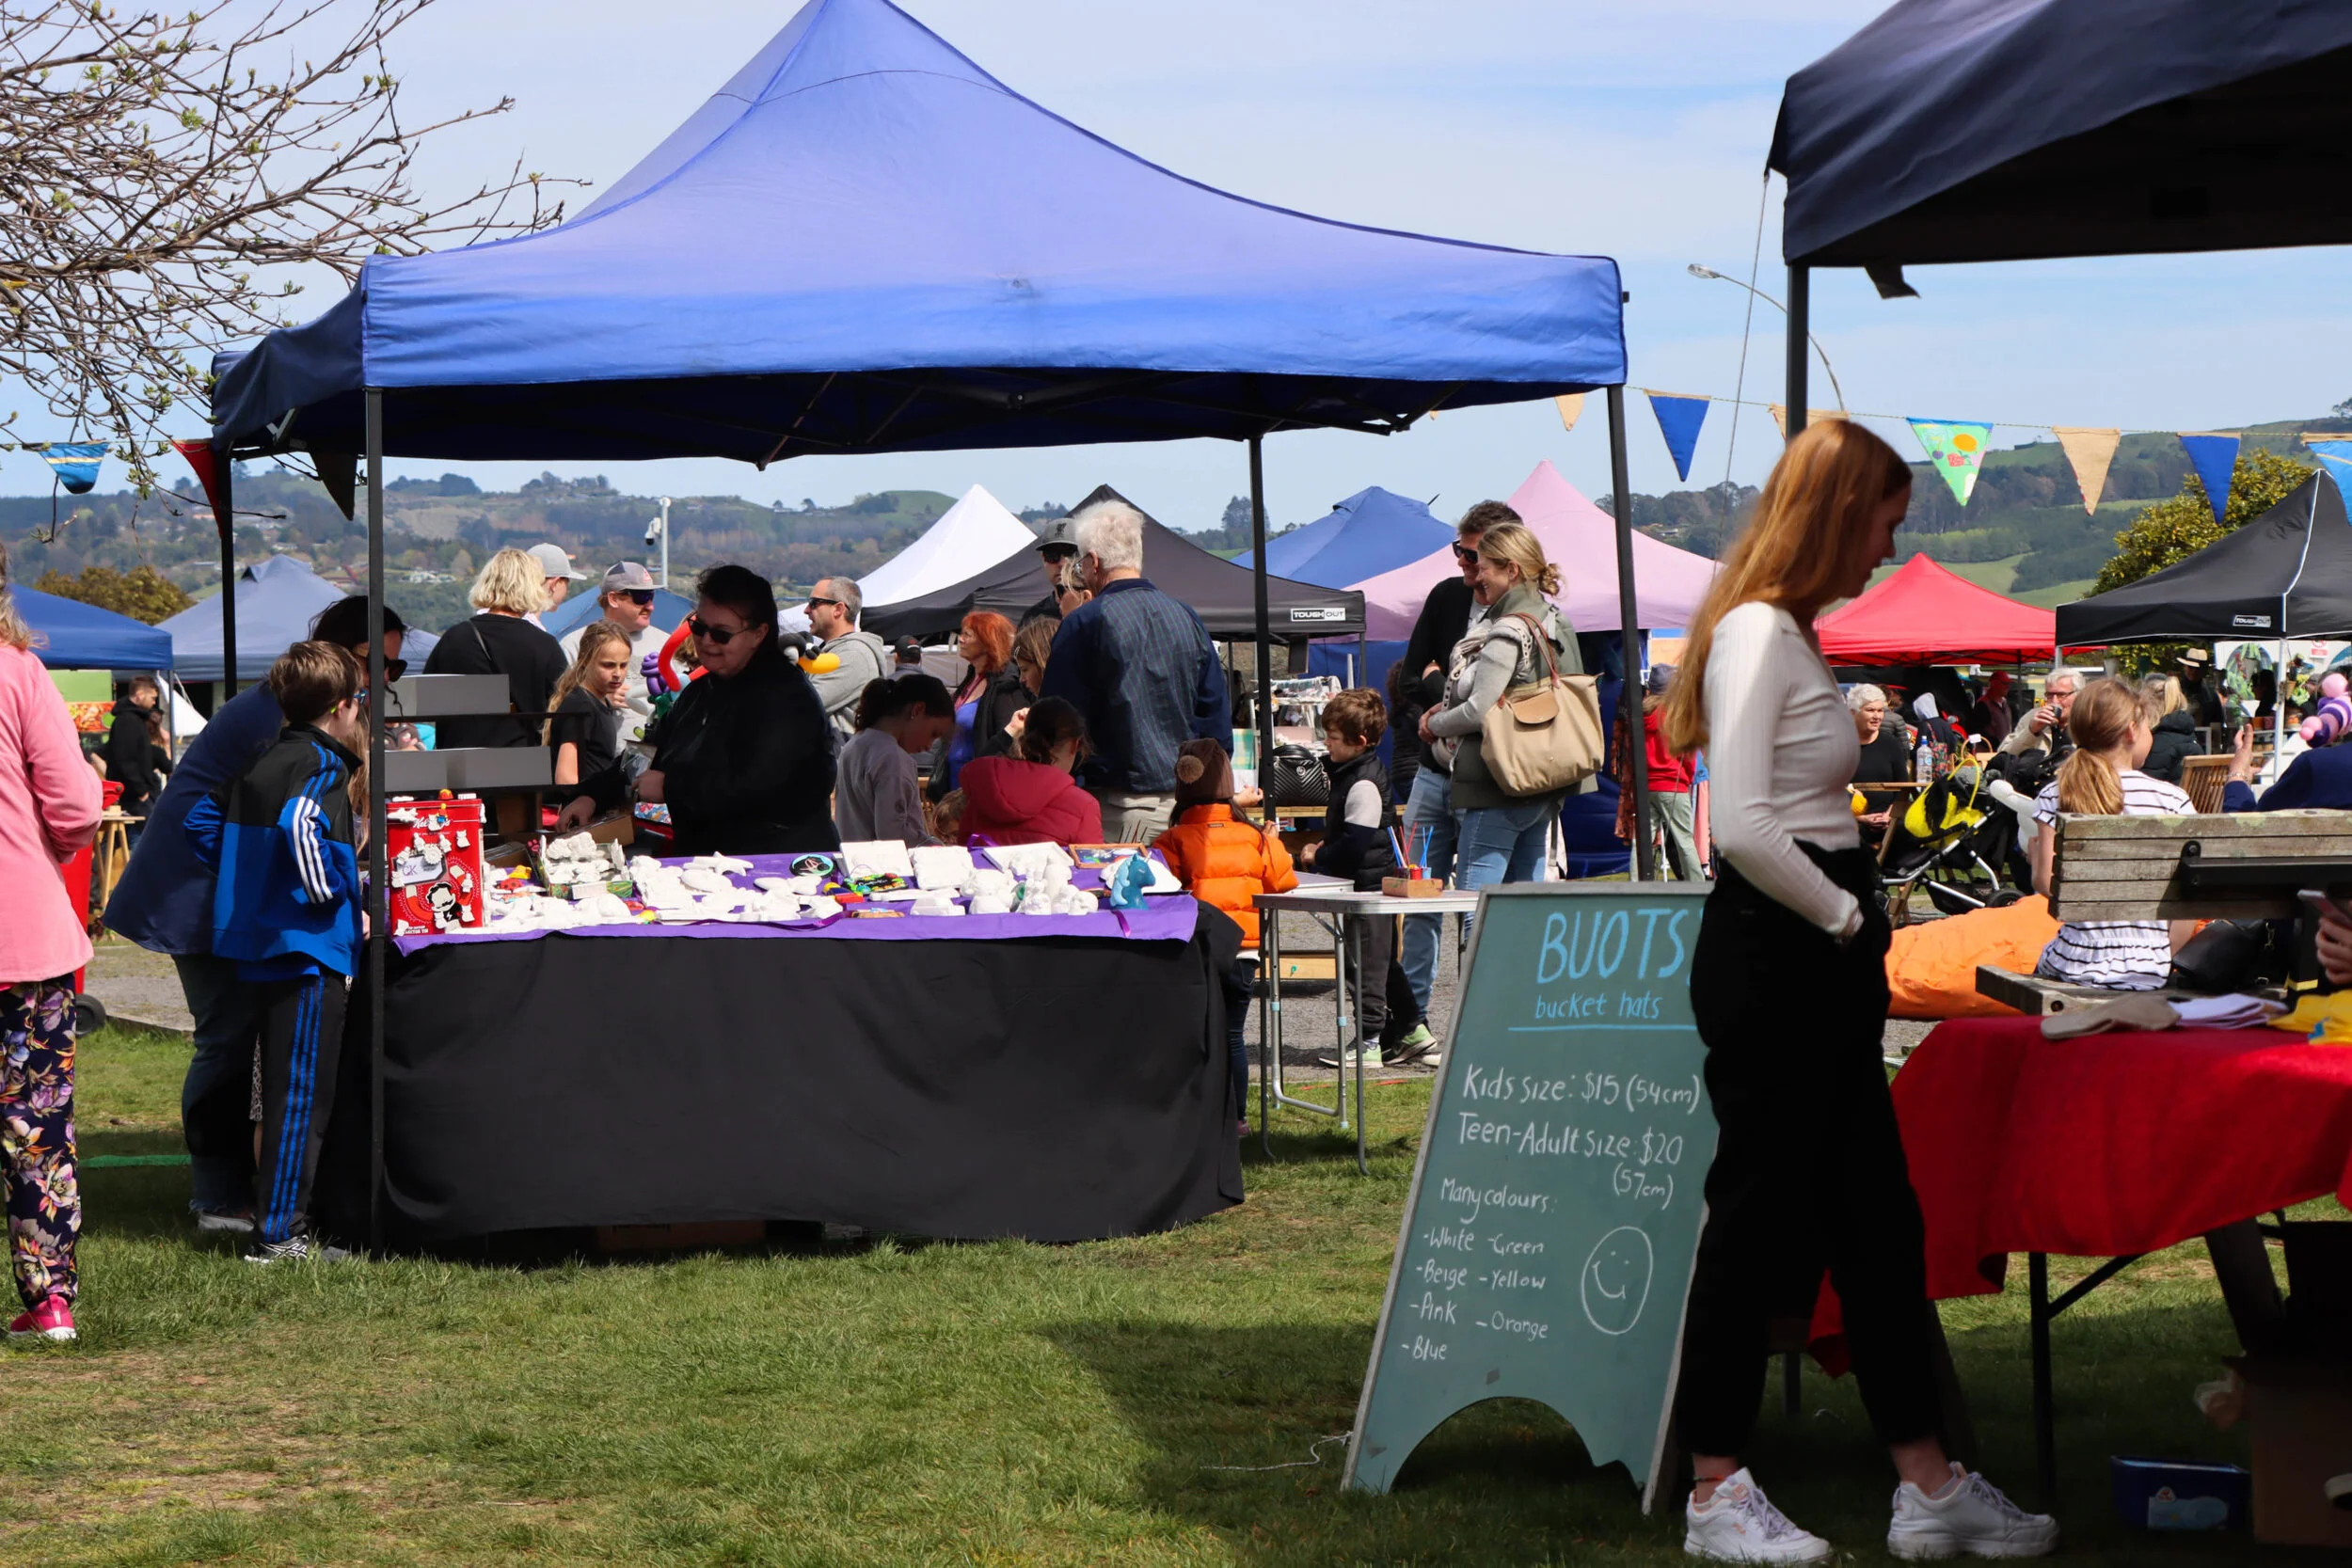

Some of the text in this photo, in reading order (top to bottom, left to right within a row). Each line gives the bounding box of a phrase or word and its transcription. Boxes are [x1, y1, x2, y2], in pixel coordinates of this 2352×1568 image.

[1535, 990, 1663, 1020] bucket hats
[1463, 1063, 1516, 1101] Kids
[1581, 1069, 1619, 1105] $15
[1626, 1073, 1700, 1115] (54cm)
[1459, 1112, 1580, 1156] Teen-Adult
[1639, 1125, 1683, 1166] $20
[1440, 1178, 1482, 1225] Many
[1613, 1162, 1674, 1211] (57cm)
